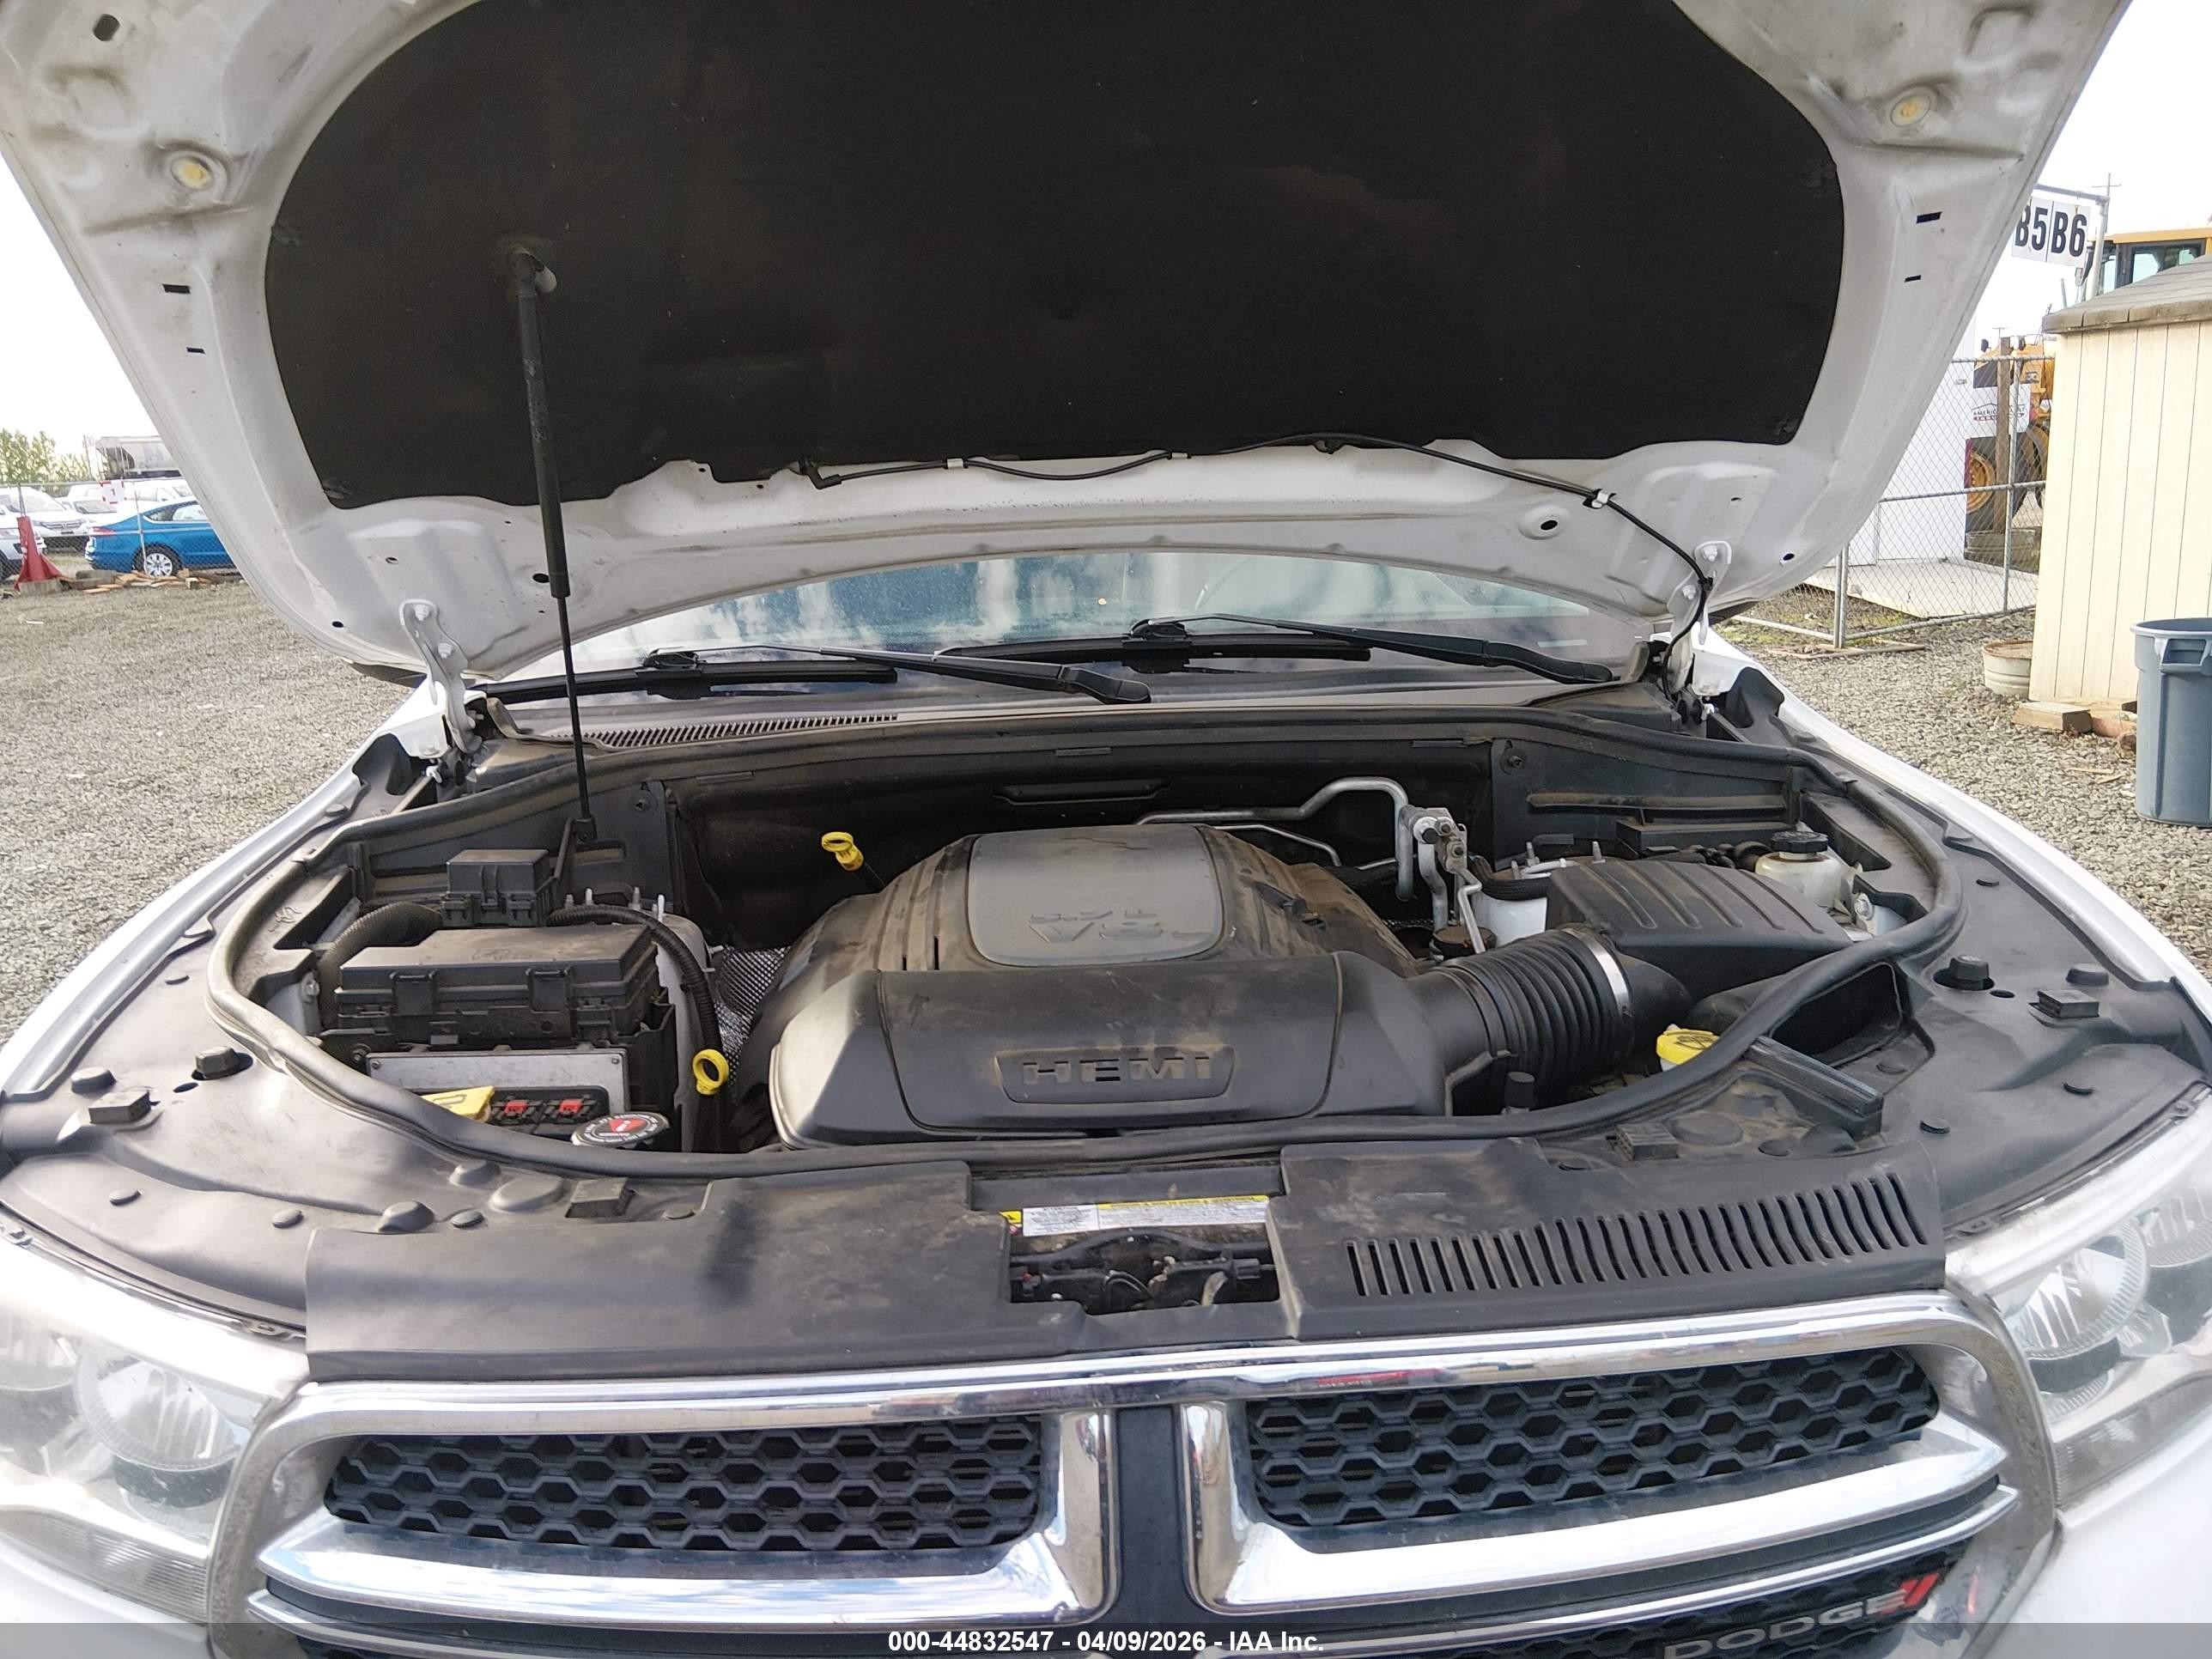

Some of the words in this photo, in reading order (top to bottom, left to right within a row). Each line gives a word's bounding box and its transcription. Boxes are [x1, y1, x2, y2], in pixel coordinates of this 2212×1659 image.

[2015, 205, 2049, 251] B5
[2051, 211, 2087, 257] B6
[1028, 921, 1164, 944] V8
[1022, 1056, 1212, 1085] HEMI
[1663, 1589, 1907, 1659] DODGE
